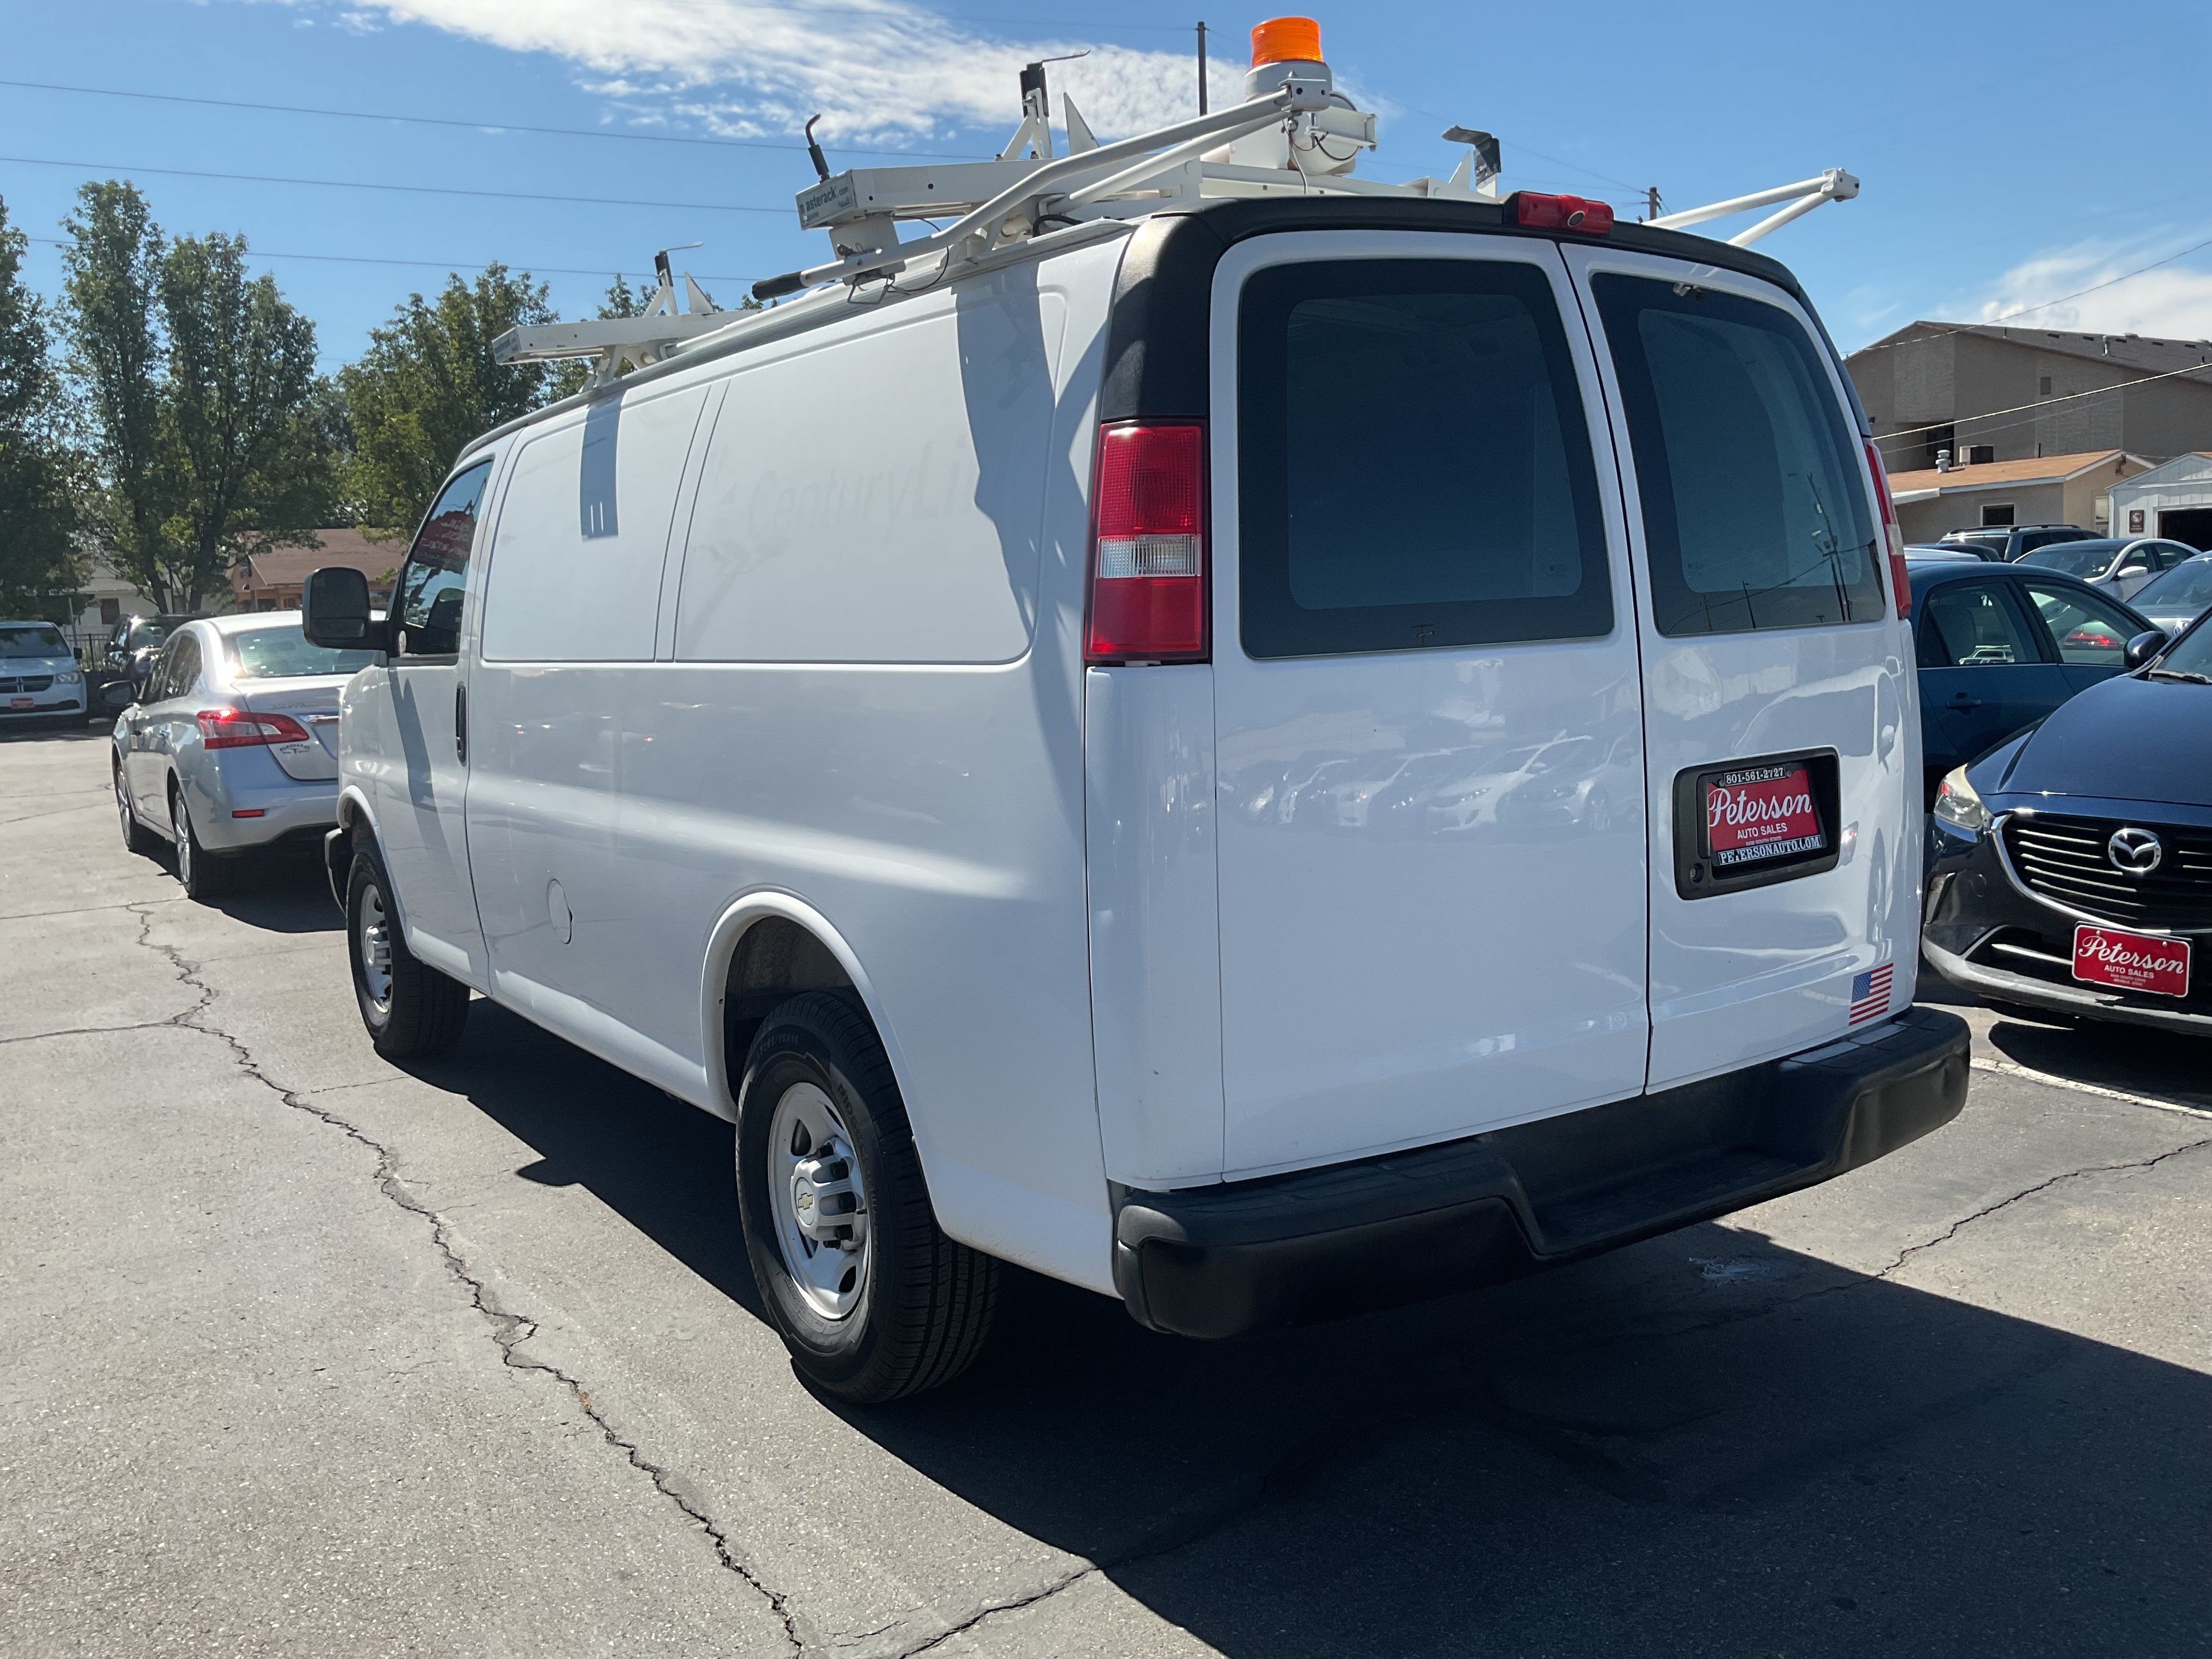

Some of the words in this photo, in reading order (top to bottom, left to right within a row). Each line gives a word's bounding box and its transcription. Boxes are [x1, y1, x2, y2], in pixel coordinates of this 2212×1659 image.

[1726, 768, 1784, 784] 801-561-2727
[1707, 787, 1812, 827] Peterson
[1737, 827, 1758, 839] AUTO
[1760, 822, 1787, 836] SALES
[2078, 936, 2184, 974] Peterson
[2104, 964, 2126, 974] AUTO
[2128, 968, 2154, 979] SALES
